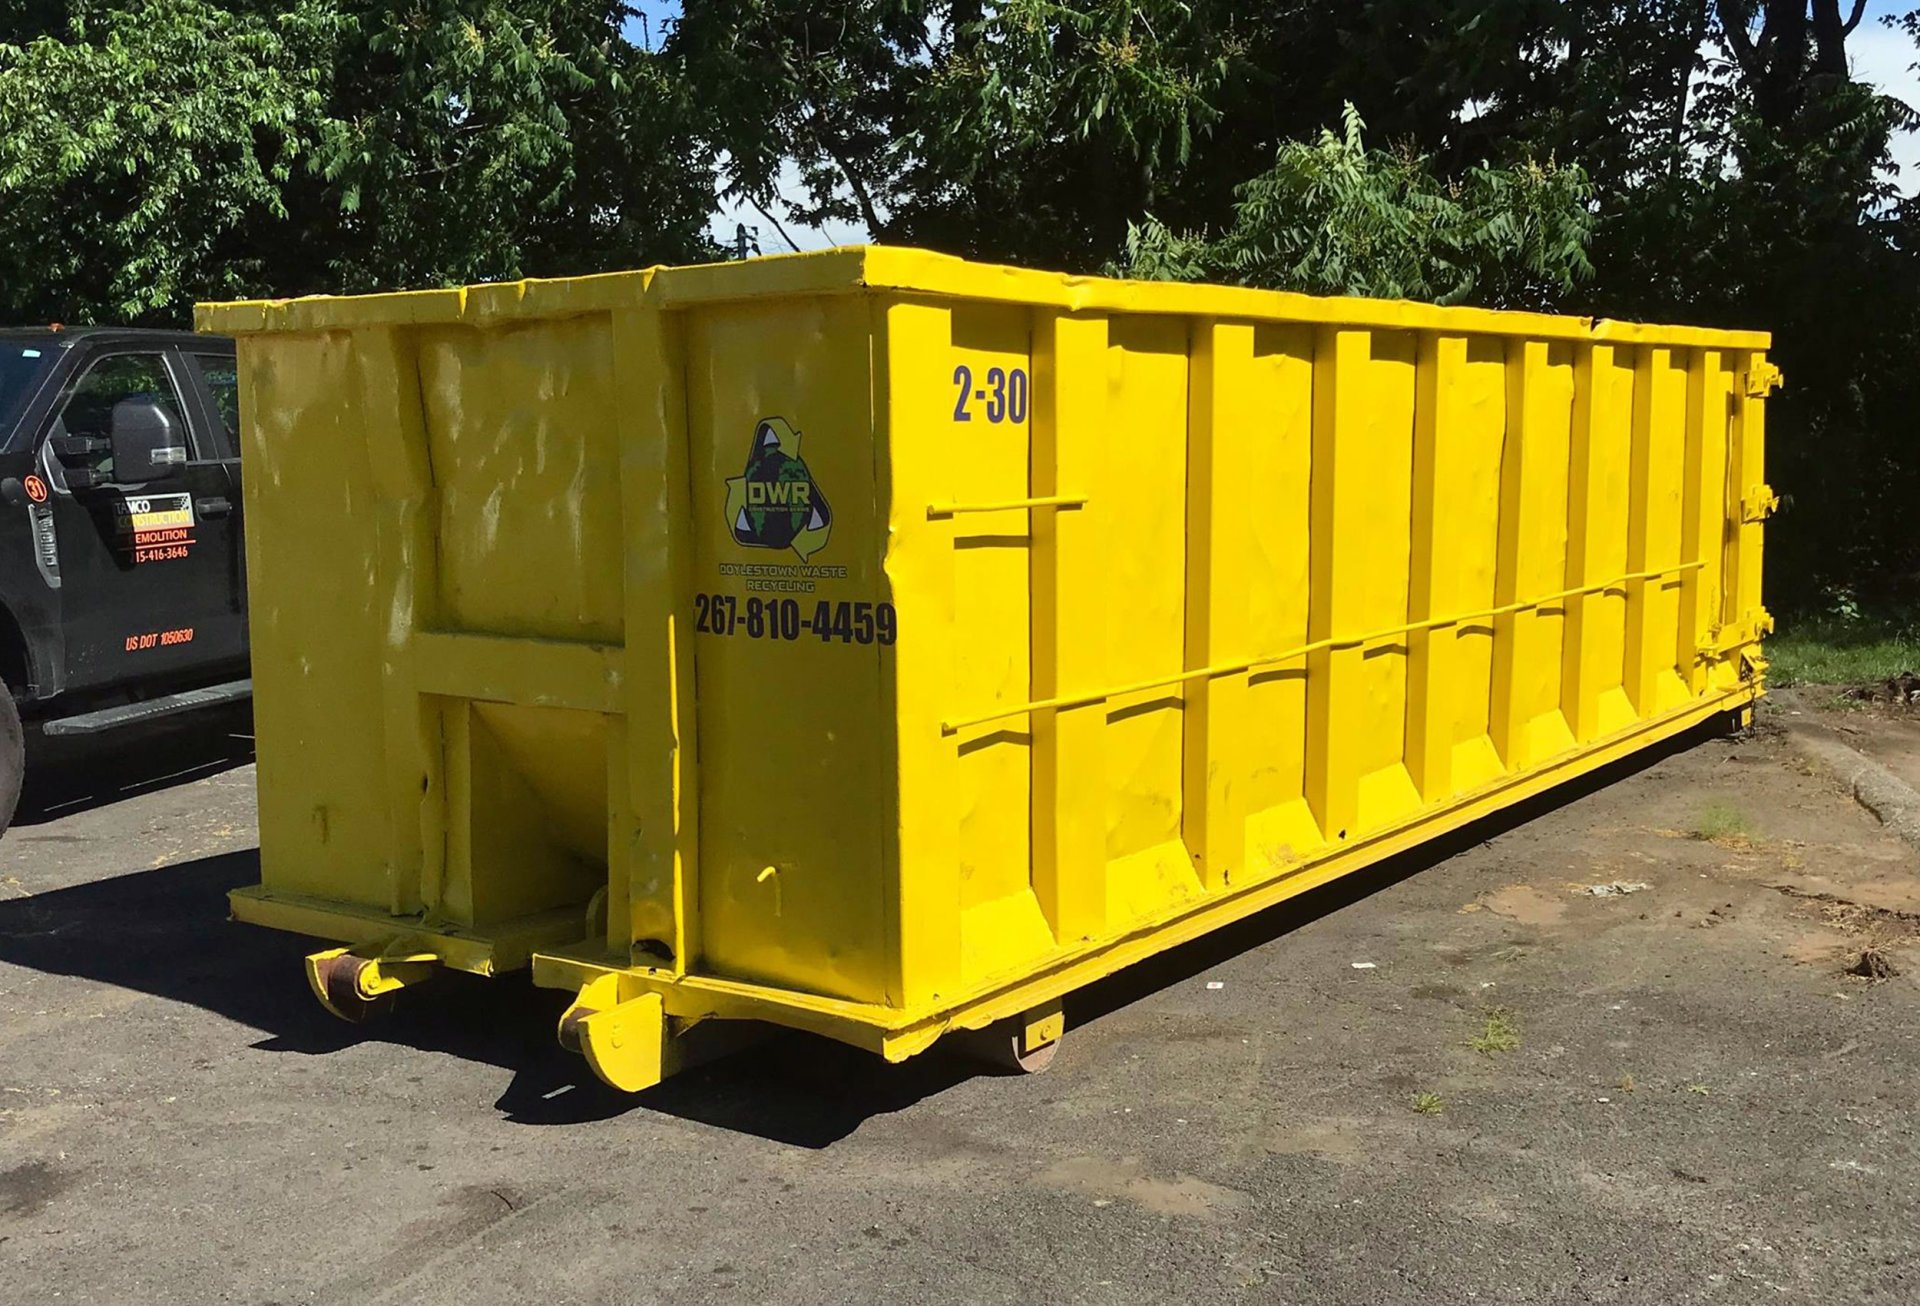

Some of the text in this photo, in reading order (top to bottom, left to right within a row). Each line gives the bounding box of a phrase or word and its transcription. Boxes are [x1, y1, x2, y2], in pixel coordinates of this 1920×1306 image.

[953, 365, 1027, 424] 2-30
[27, 480, 43, 497] 31
[748, 481, 810, 504] DWR
[134, 530, 187, 544] EMOLITION
[132, 546, 188, 563] 15-416-3646
[719, 564, 847, 578] DOYLESTOWN WASTE
[747, 581, 815, 593] RECYCLING
[695, 593, 897, 645] 267-810-4459
[126, 636, 138, 651] US
[140, 634, 158, 649] DOT
